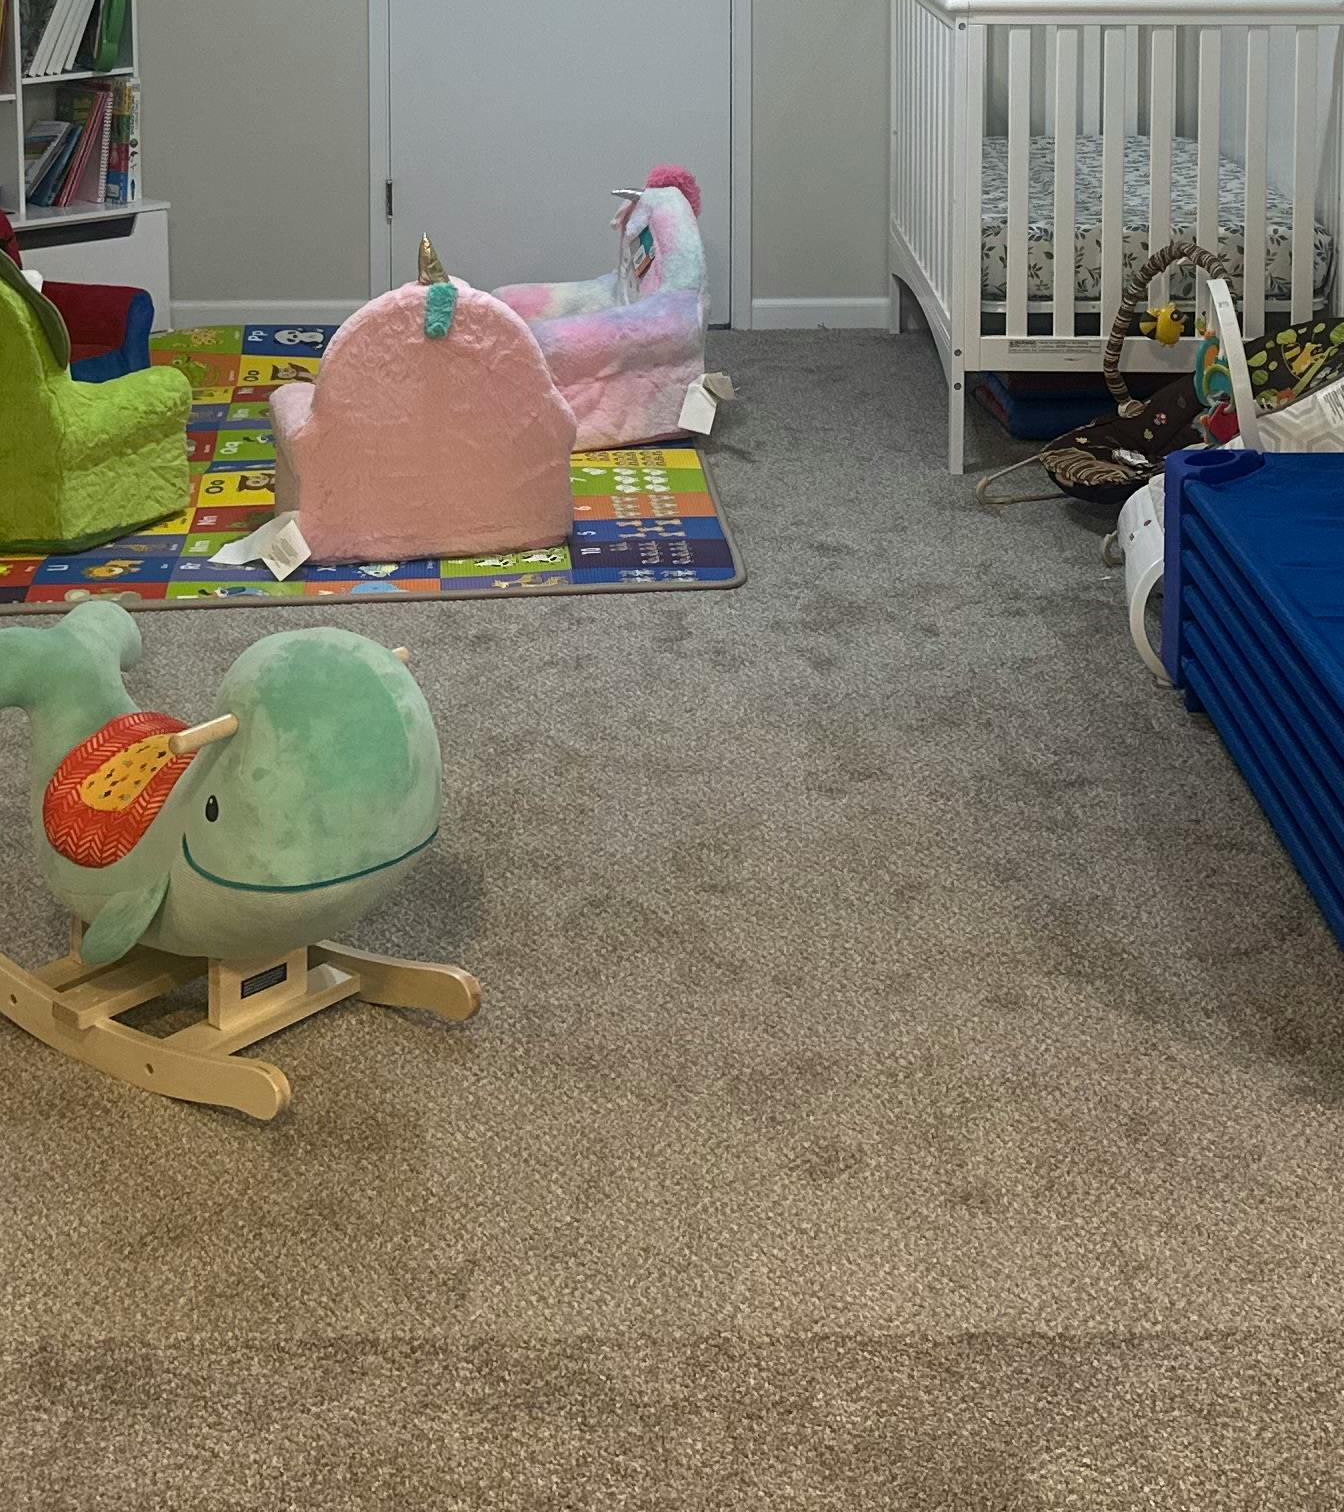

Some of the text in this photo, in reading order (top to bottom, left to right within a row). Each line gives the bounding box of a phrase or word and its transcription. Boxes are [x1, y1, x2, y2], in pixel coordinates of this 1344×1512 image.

[248, 330, 269, 342] Pp
[243, 370, 260, 382] Oo
[220, 440, 244, 455] Qq
[204, 479, 225, 495] Oo
